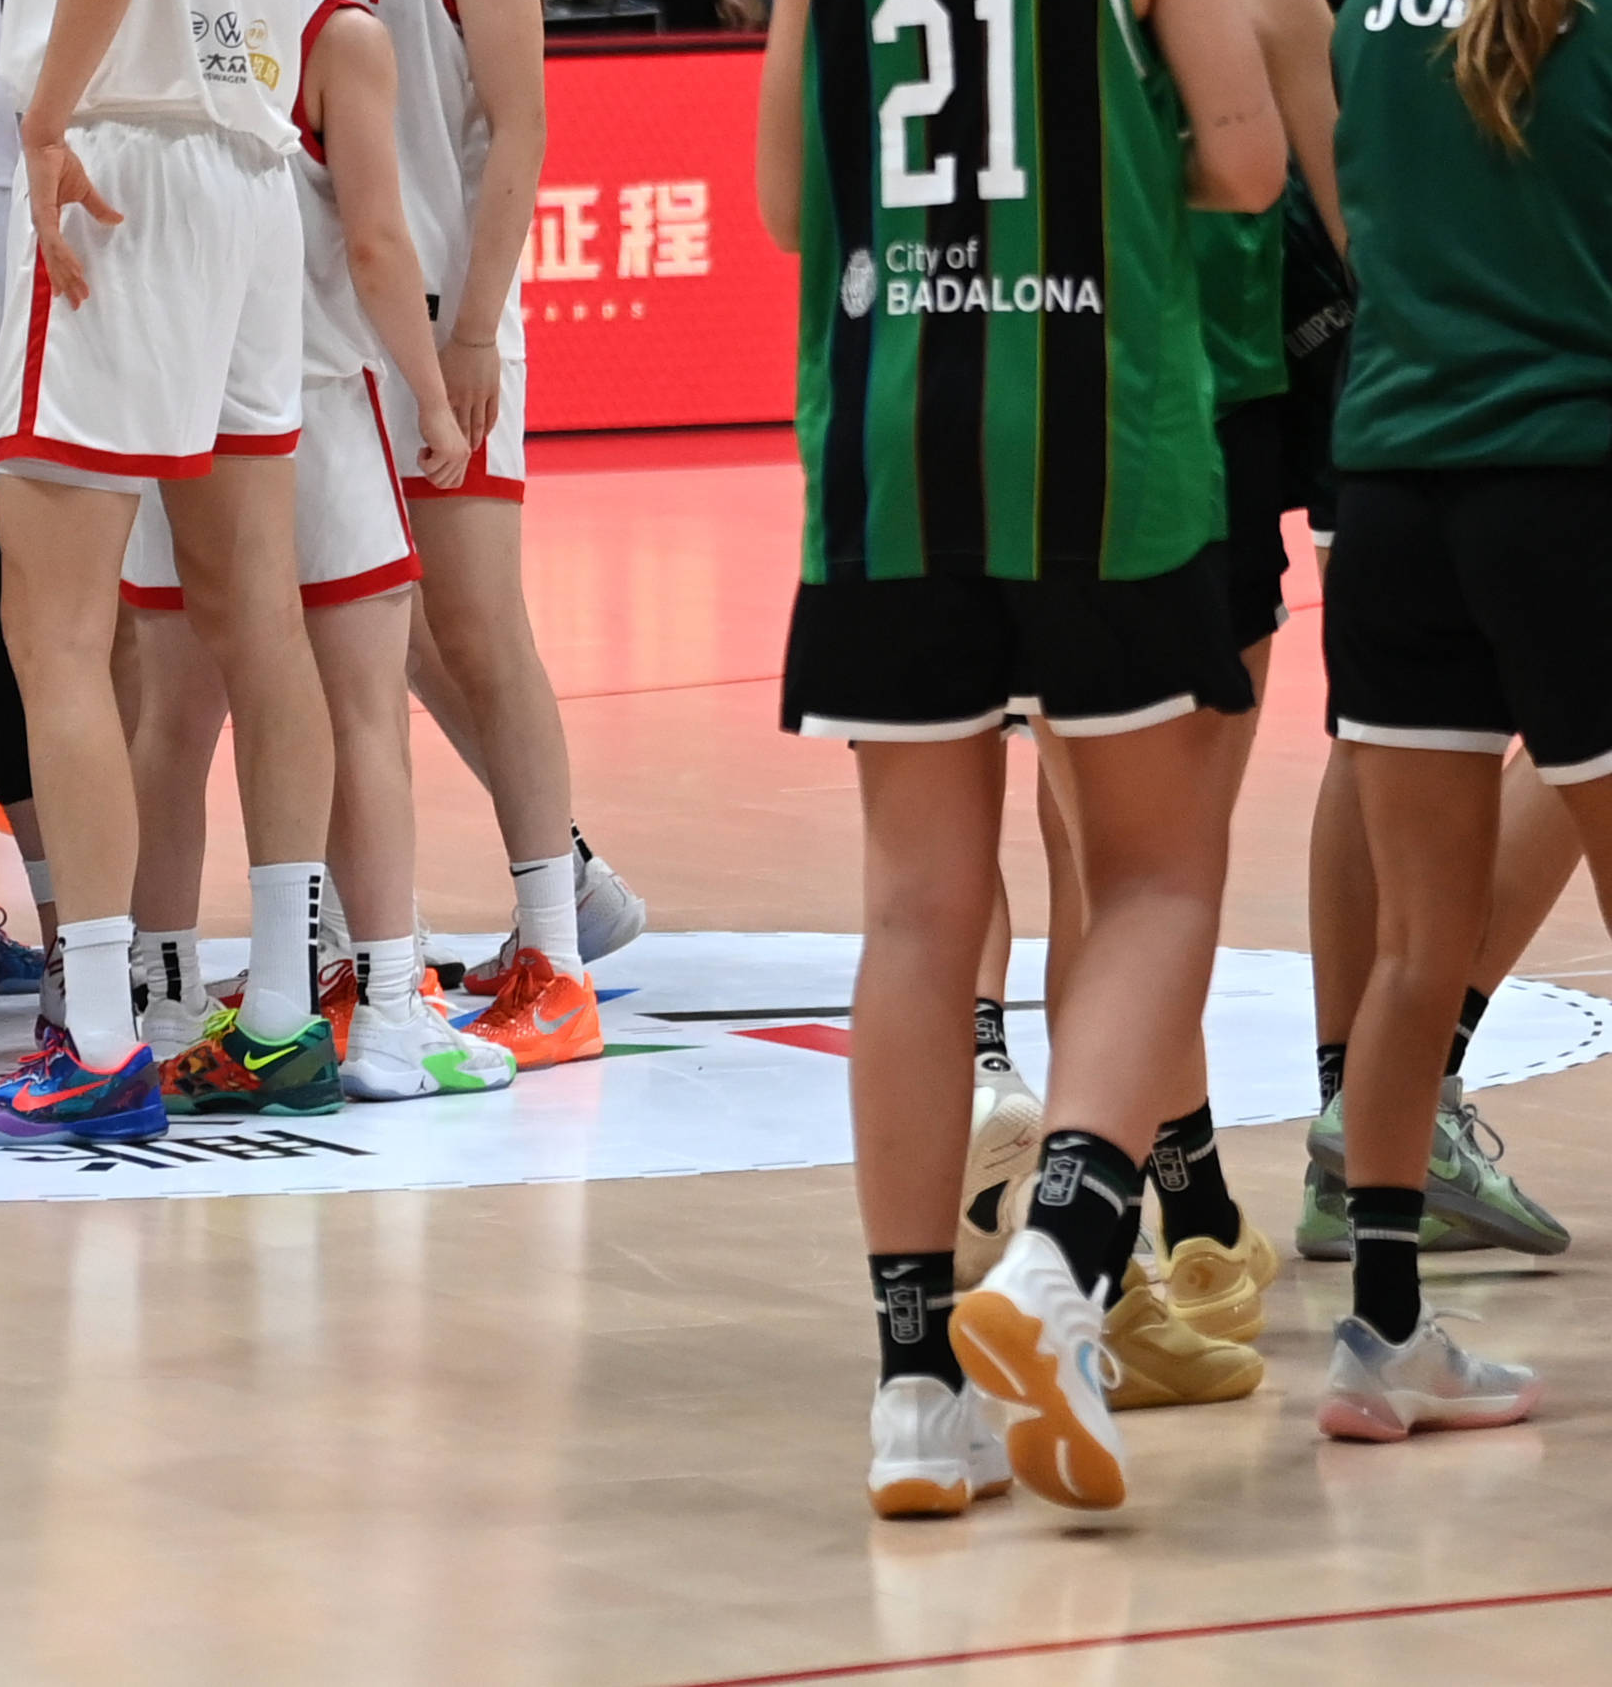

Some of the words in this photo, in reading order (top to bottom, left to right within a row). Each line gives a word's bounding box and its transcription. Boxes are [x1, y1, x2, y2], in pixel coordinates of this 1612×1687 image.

[886, 243, 940, 277] City
[945, 237, 980, 270] of
[886, 277, 1103, 316] BADALONA
